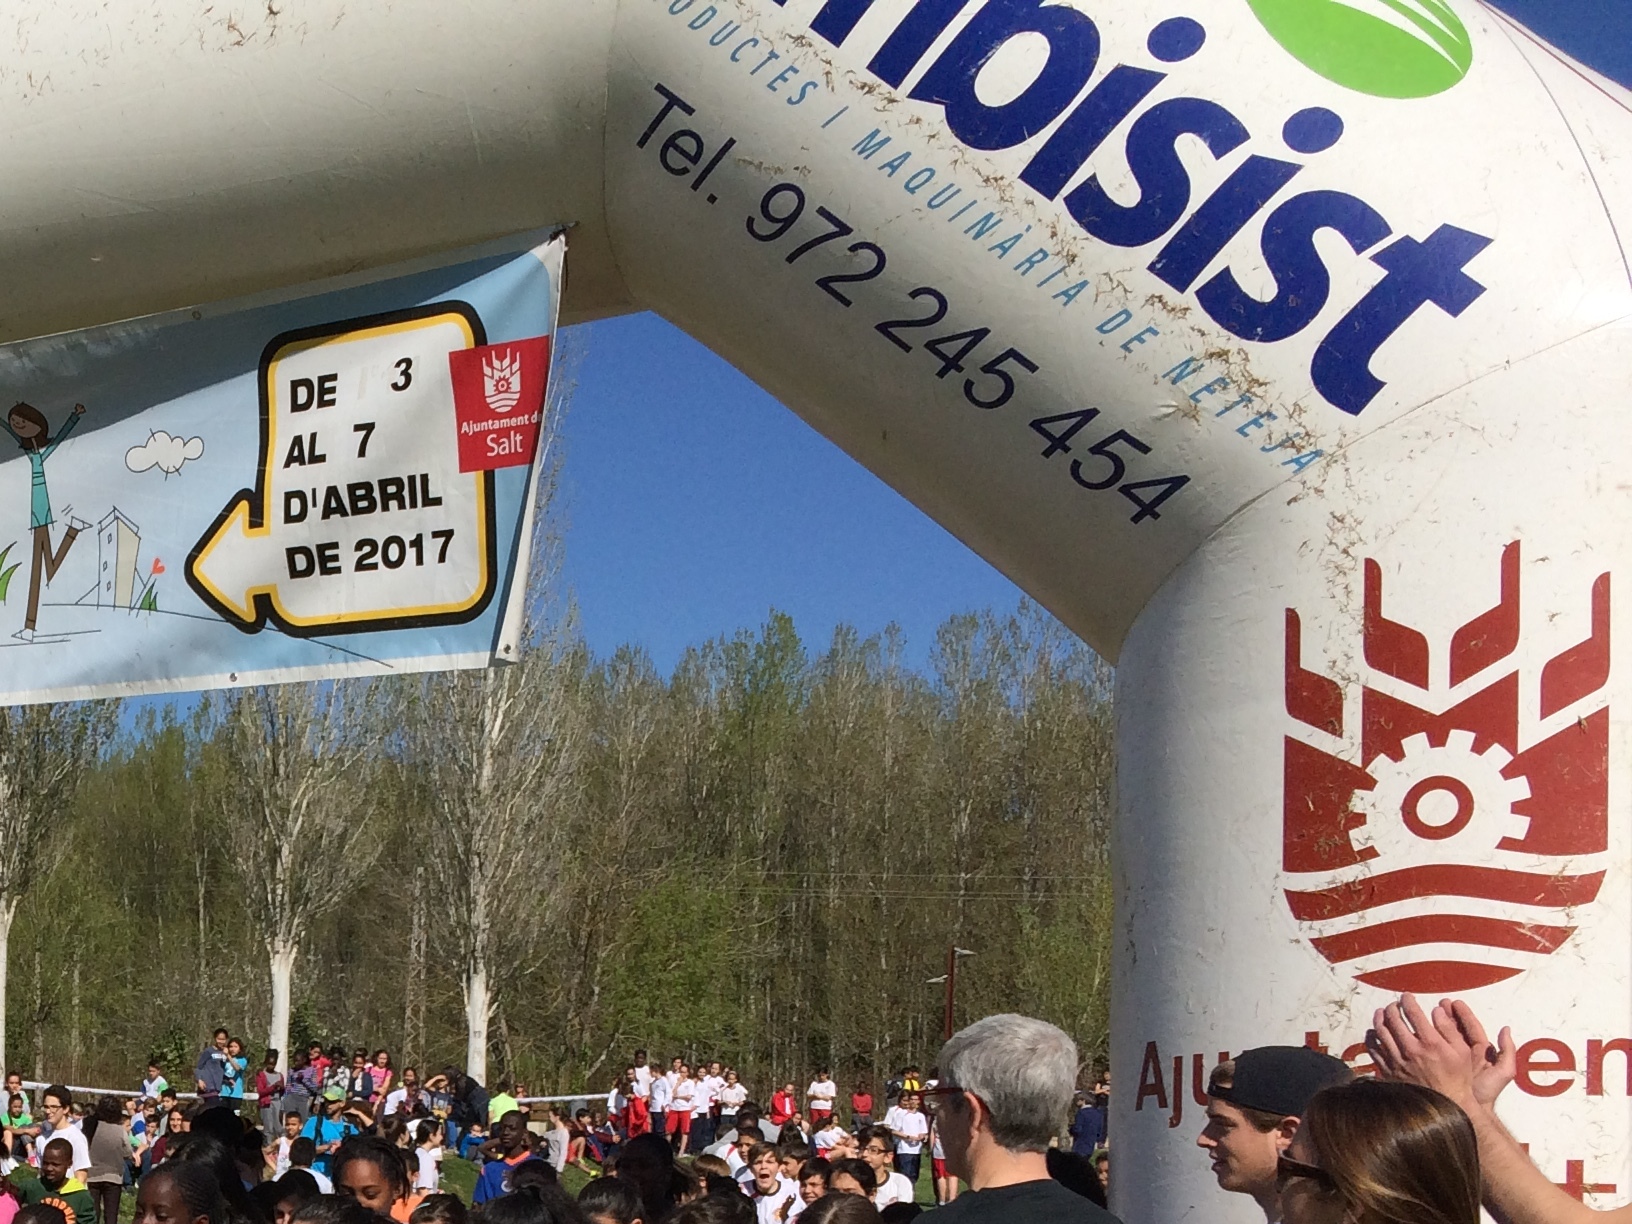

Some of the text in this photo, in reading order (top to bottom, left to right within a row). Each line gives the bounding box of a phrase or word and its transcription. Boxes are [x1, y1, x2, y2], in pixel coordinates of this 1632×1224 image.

[636, 83, 1191, 525] Tel. 972 245 454
[821, 105, 849, 128] I
[852, 128, 1089, 306] MAQUINÀRIA
[1095, 308, 1160, 353] DE
[1161, 356, 1324, 474] NETEJA
[290, 356, 413, 413] DE 3
[283, 422, 376, 470] AL 7
[461, 414, 529, 436] Ajuntament
[486, 430, 523, 457] Salt
[283, 473, 443, 525] D'ABRIL
[284, 528, 455, 579] DE 2017
